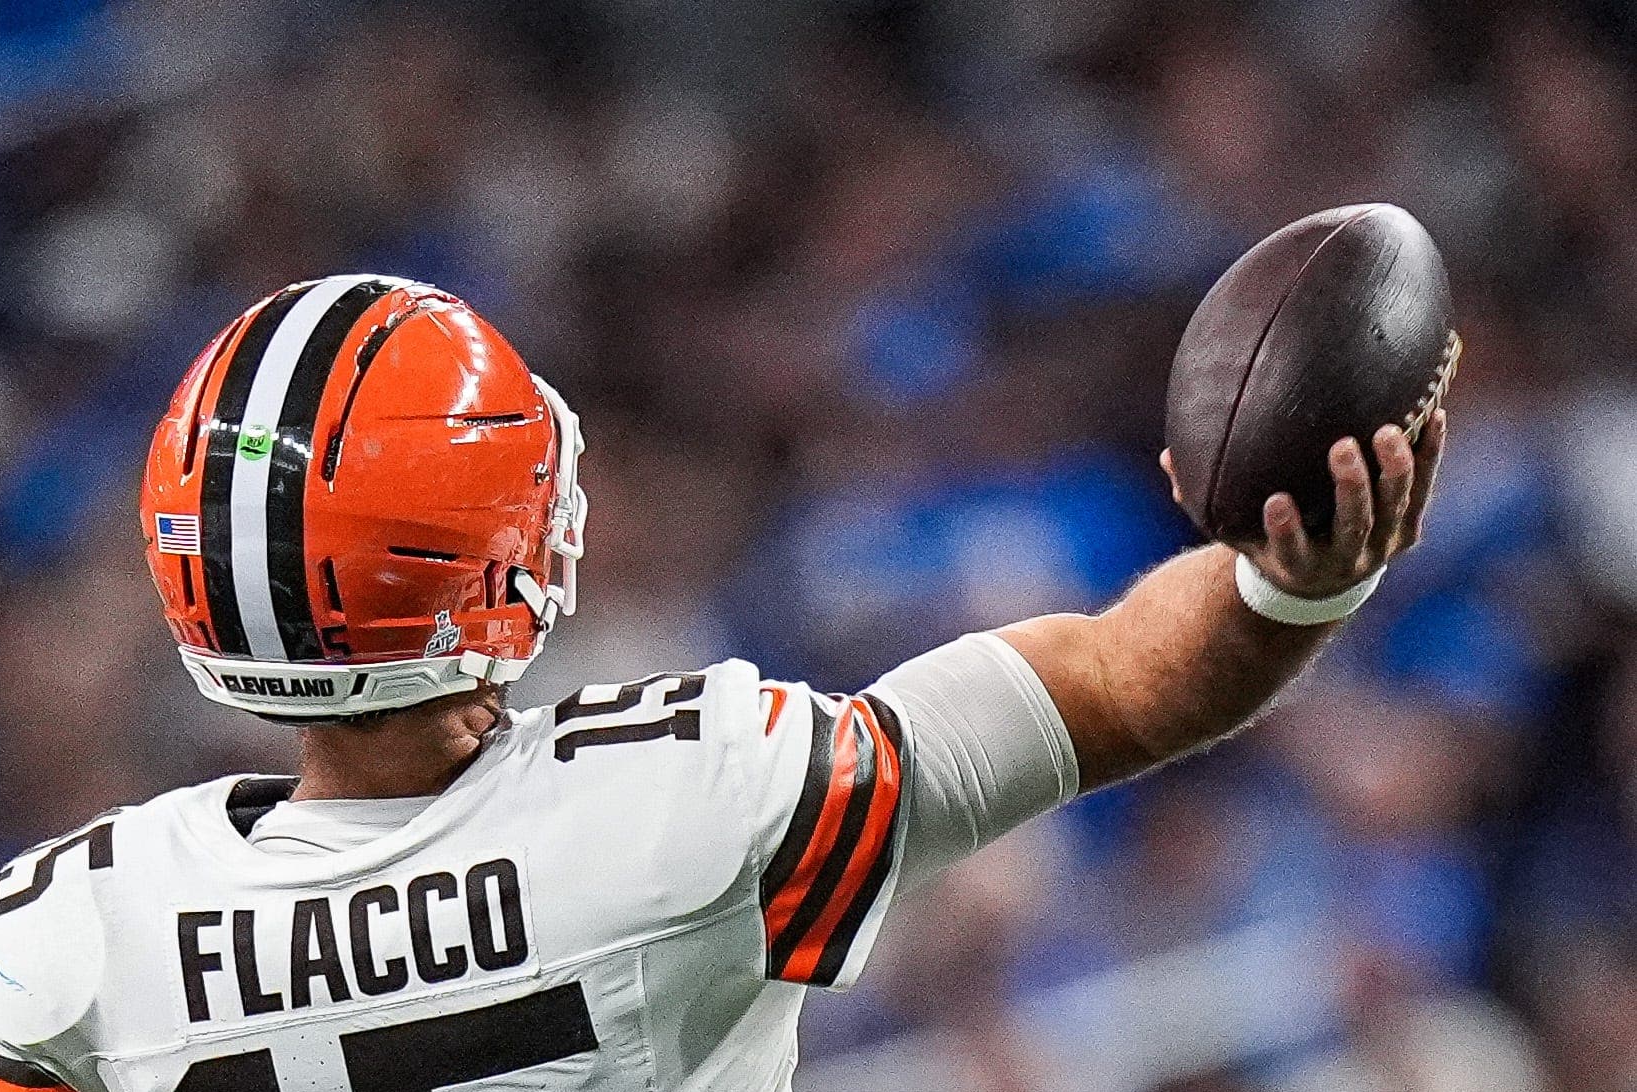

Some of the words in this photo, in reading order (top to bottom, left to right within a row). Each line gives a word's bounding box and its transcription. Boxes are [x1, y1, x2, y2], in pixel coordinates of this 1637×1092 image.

[221, 674, 334, 697] CLEVELAND
[554, 674, 706, 763] 15
[178, 857, 530, 1022] FLACCO
